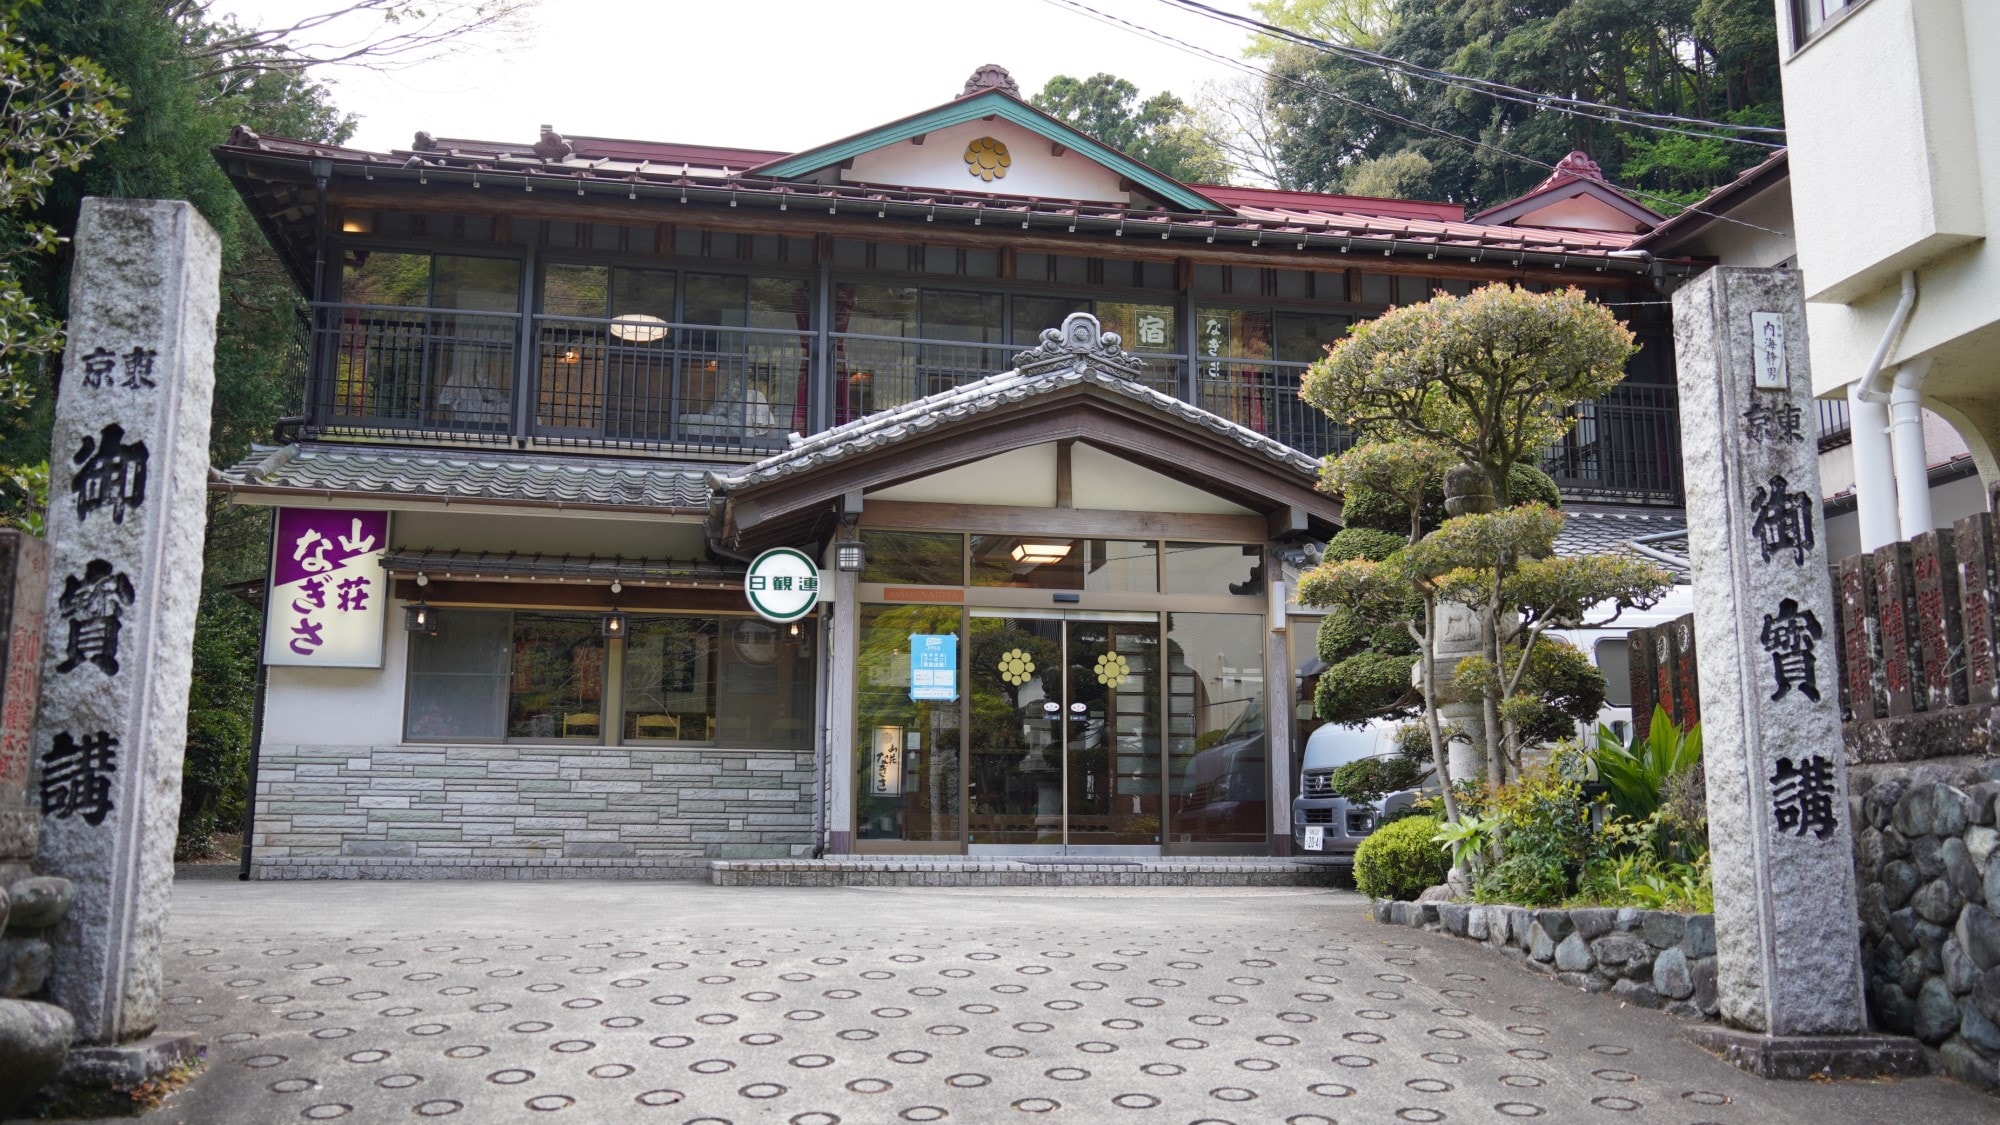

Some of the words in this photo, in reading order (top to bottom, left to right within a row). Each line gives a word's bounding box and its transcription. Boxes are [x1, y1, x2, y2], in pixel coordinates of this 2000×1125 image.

[1138, 315, 1165, 344] 宿
[1206, 318, 1222, 378] なぎさ
[82, 346, 158, 390] 東京
[1743, 402, 1804, 446] 東京
[337, 517, 376, 612] 山荘
[749, 576, 818, 592] 日観連
[289, 528, 334, 656] なぎさ
